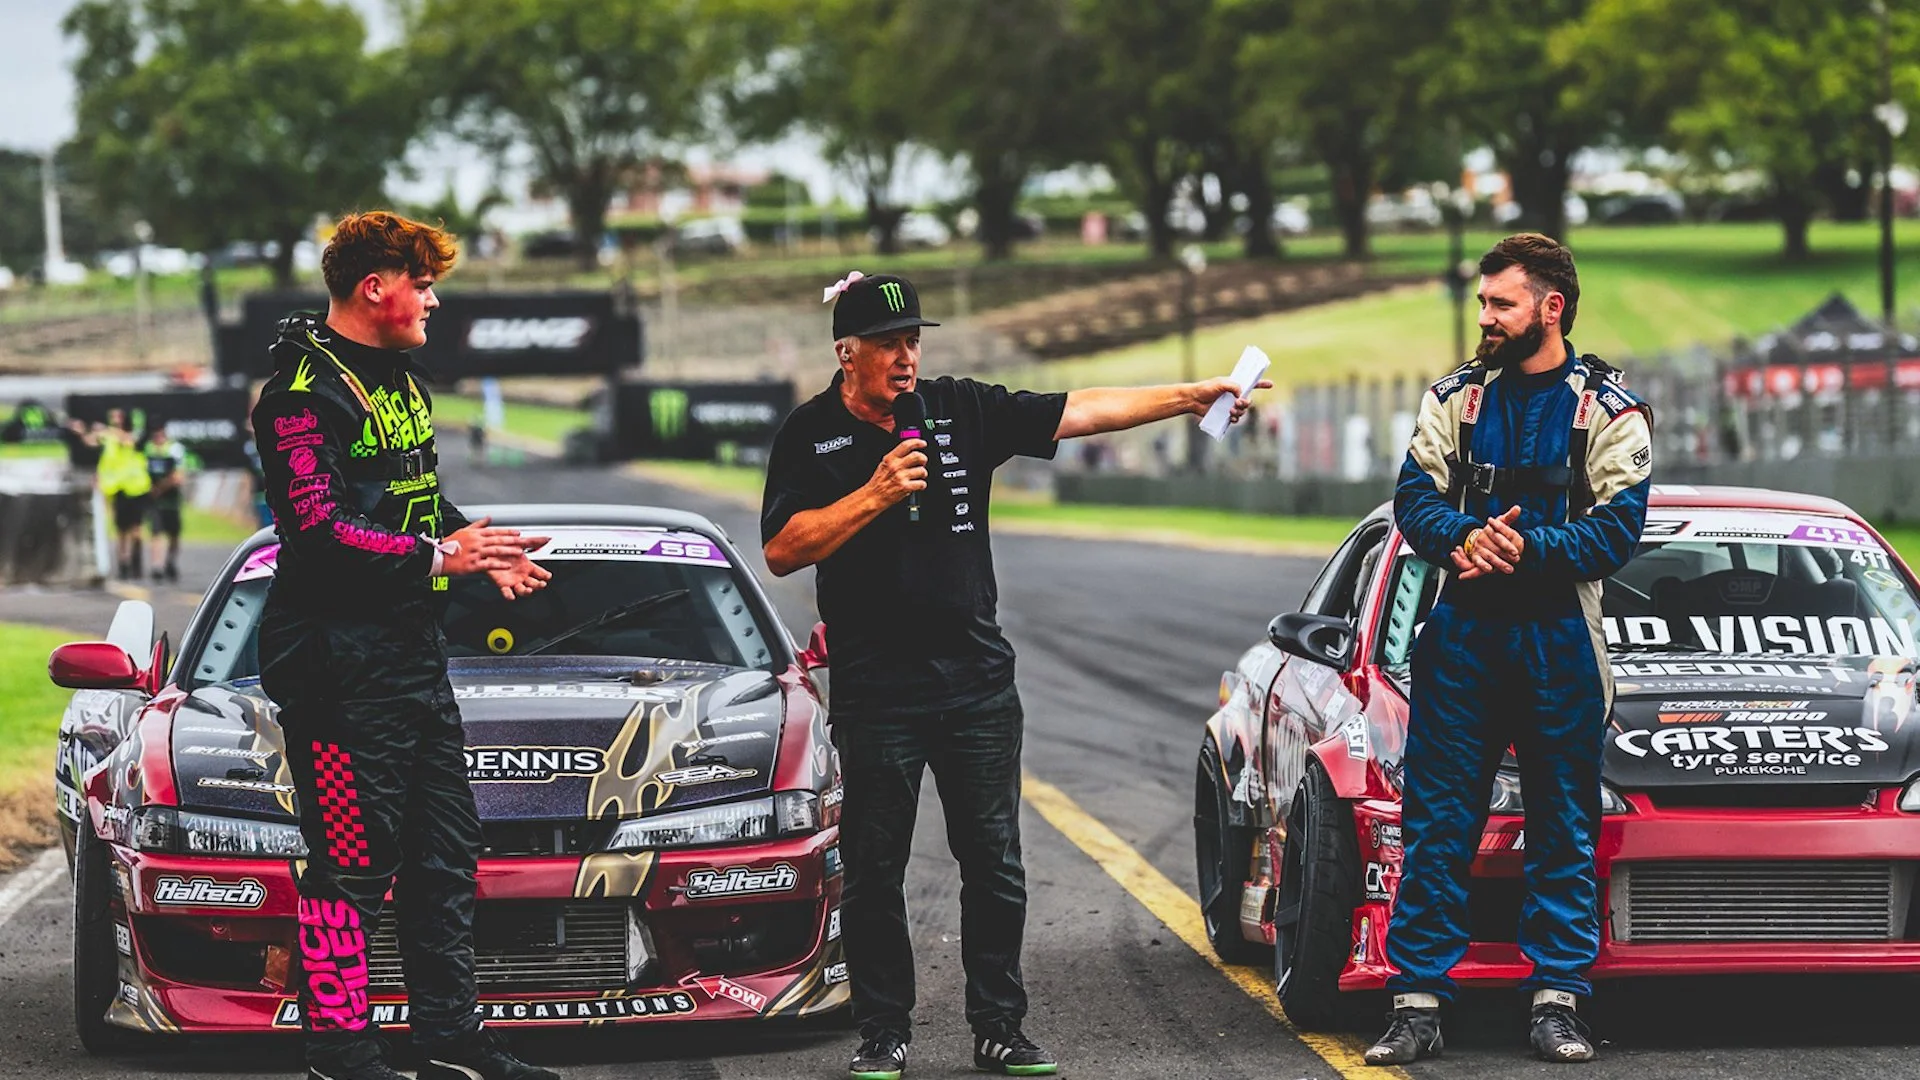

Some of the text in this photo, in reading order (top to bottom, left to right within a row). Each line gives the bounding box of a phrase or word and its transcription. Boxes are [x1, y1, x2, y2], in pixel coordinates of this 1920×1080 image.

[1437, 379, 1461, 395] OMP
[1466, 387, 1481, 421] SIMPSON
[1577, 393, 1592, 427] SIMPSON
[1602, 392, 1625, 412] OMP
[1632, 450, 1651, 467] OMP
[1806, 527, 1877, 544] 411
[660, 541, 711, 559] 58
[1688, 616, 1918, 658] VISION
[1643, 681, 1833, 693] SUNSET SPACES
[1724, 711, 1827, 722] Repco
[1614, 727, 1889, 758] CARTER'S
[1670, 751, 1862, 770] tyre service
[506, 770, 548, 778] PAINT
[1714, 765, 1806, 776] PUKEKOHE
[691, 867, 796, 893] Haltech
[157, 880, 264, 904] Haltech
[717, 979, 762, 1007] TOW
